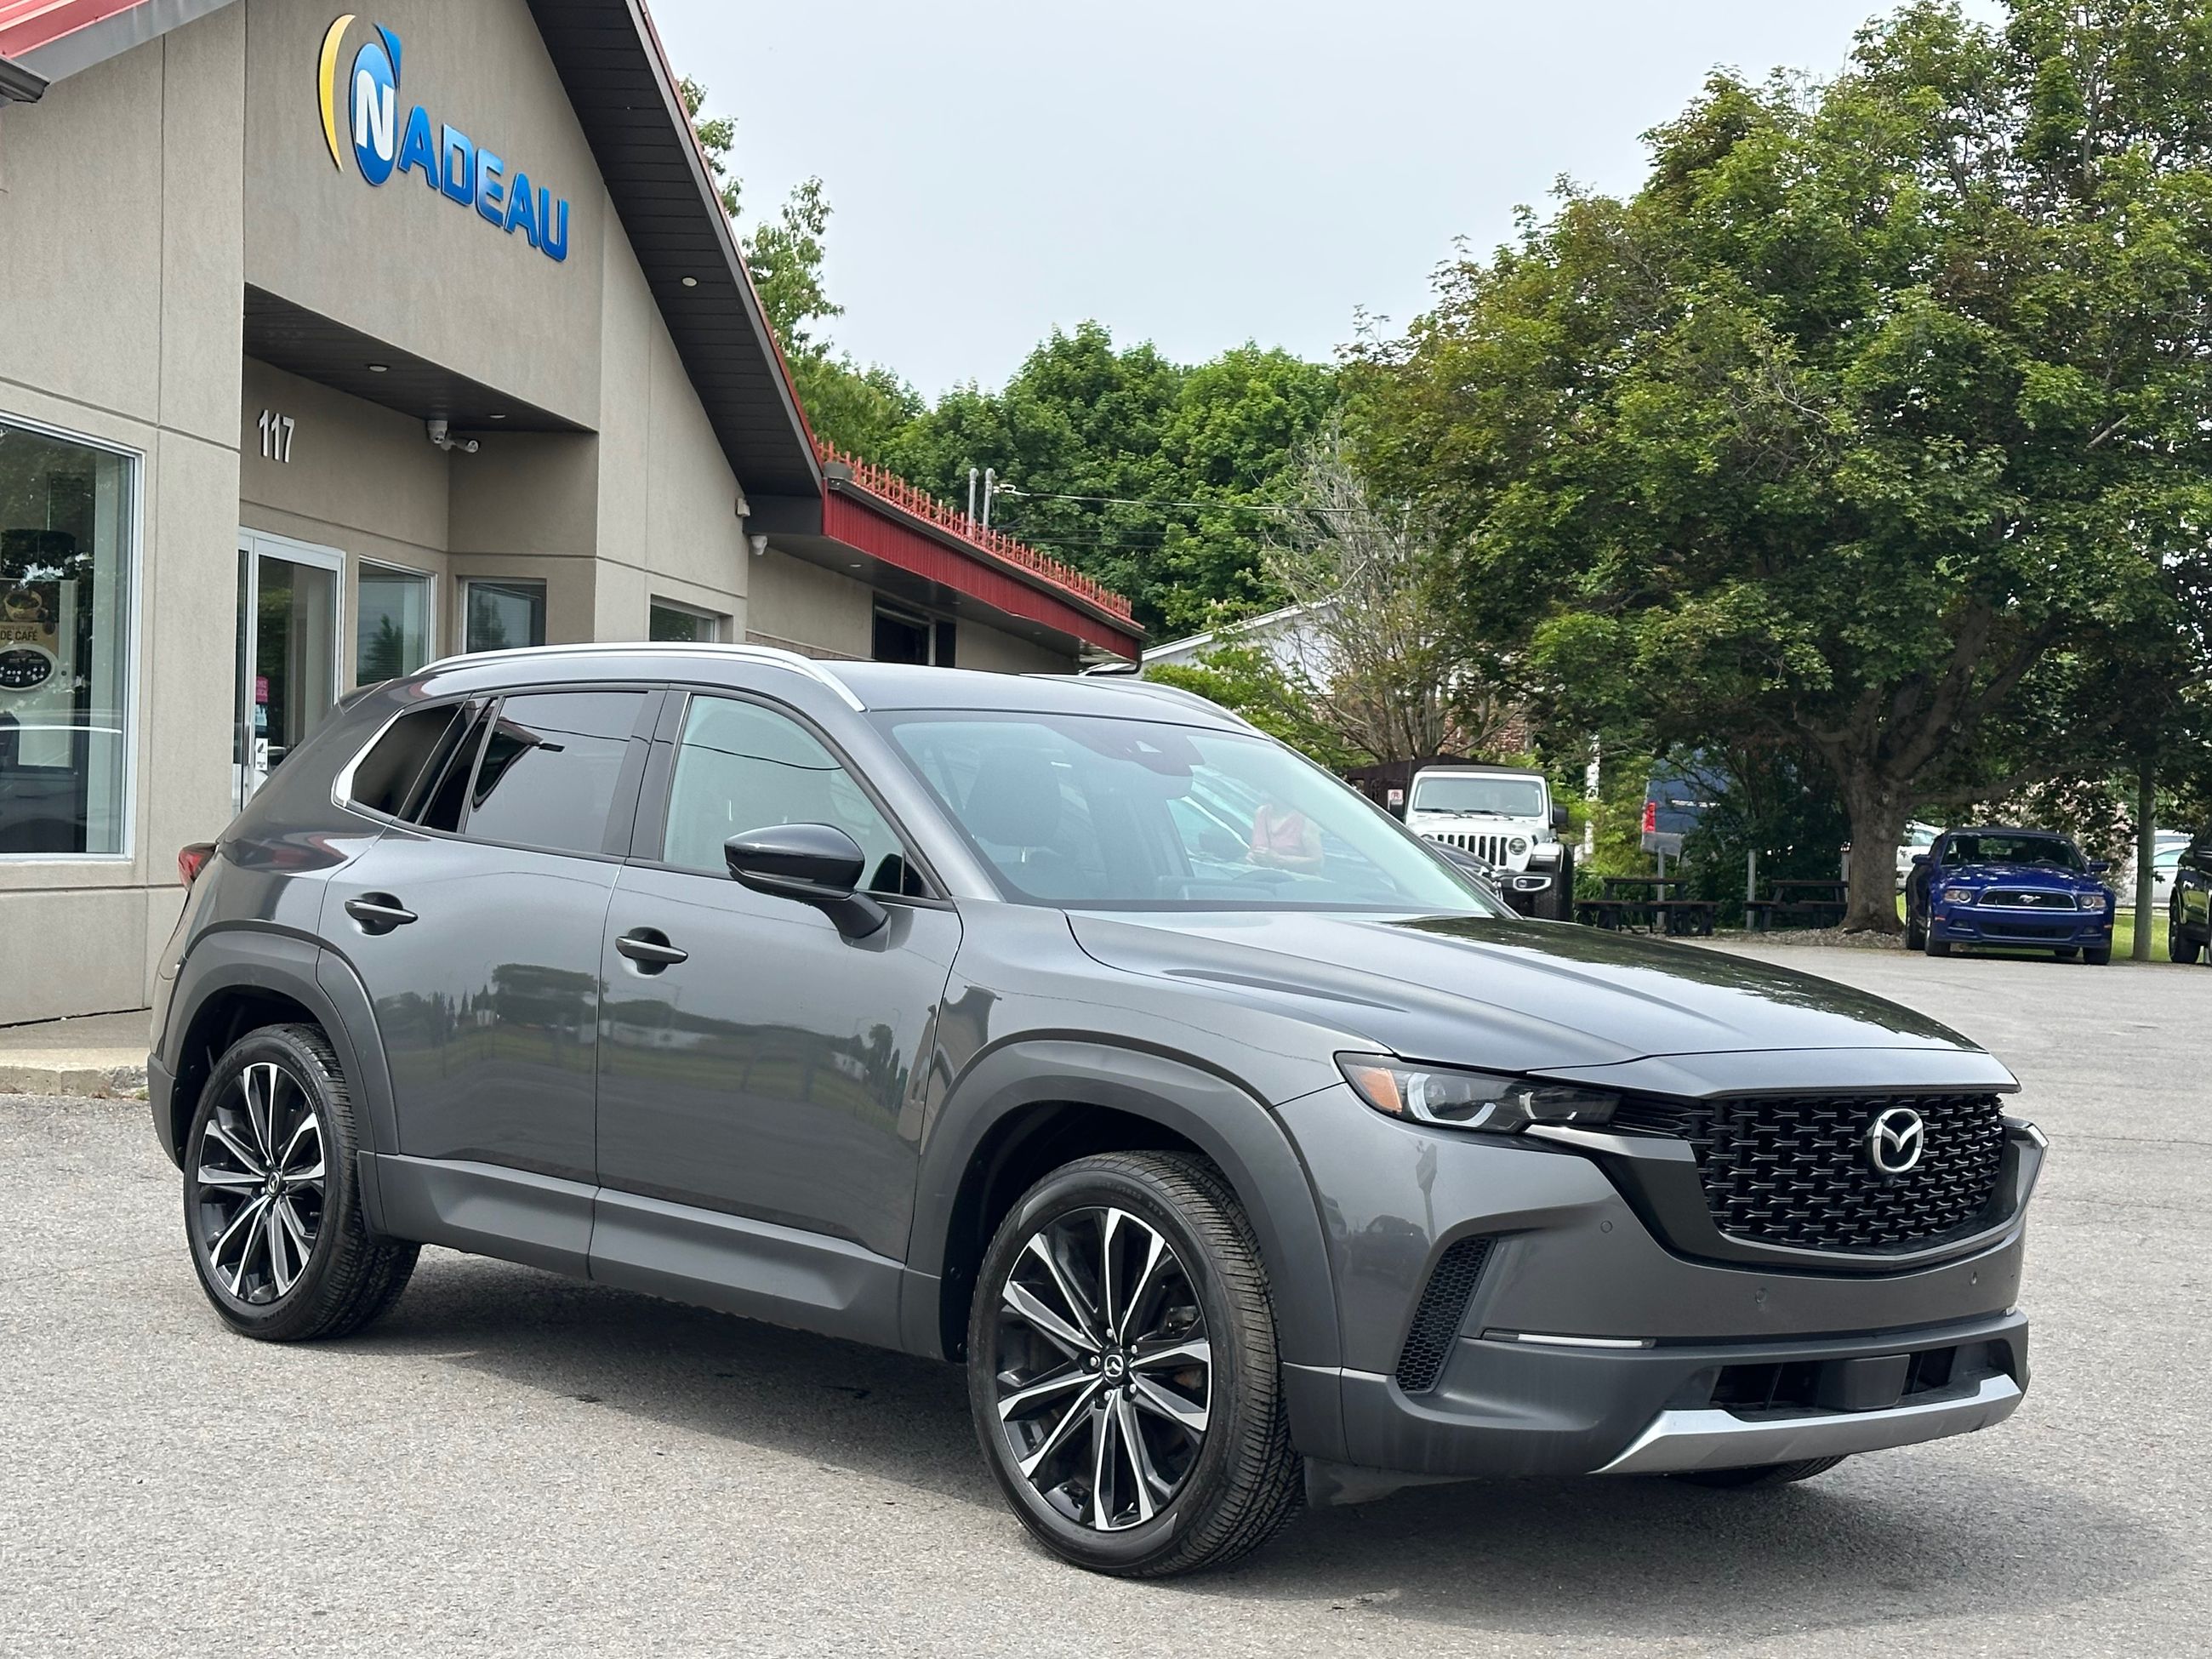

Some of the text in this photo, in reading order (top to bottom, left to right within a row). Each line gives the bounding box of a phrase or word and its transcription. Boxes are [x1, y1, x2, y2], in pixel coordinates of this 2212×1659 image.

[354, 68, 570, 263] NADEAU
[258, 409, 295, 463] 117
[0, 629, 38, 641] DE CAFÉ
